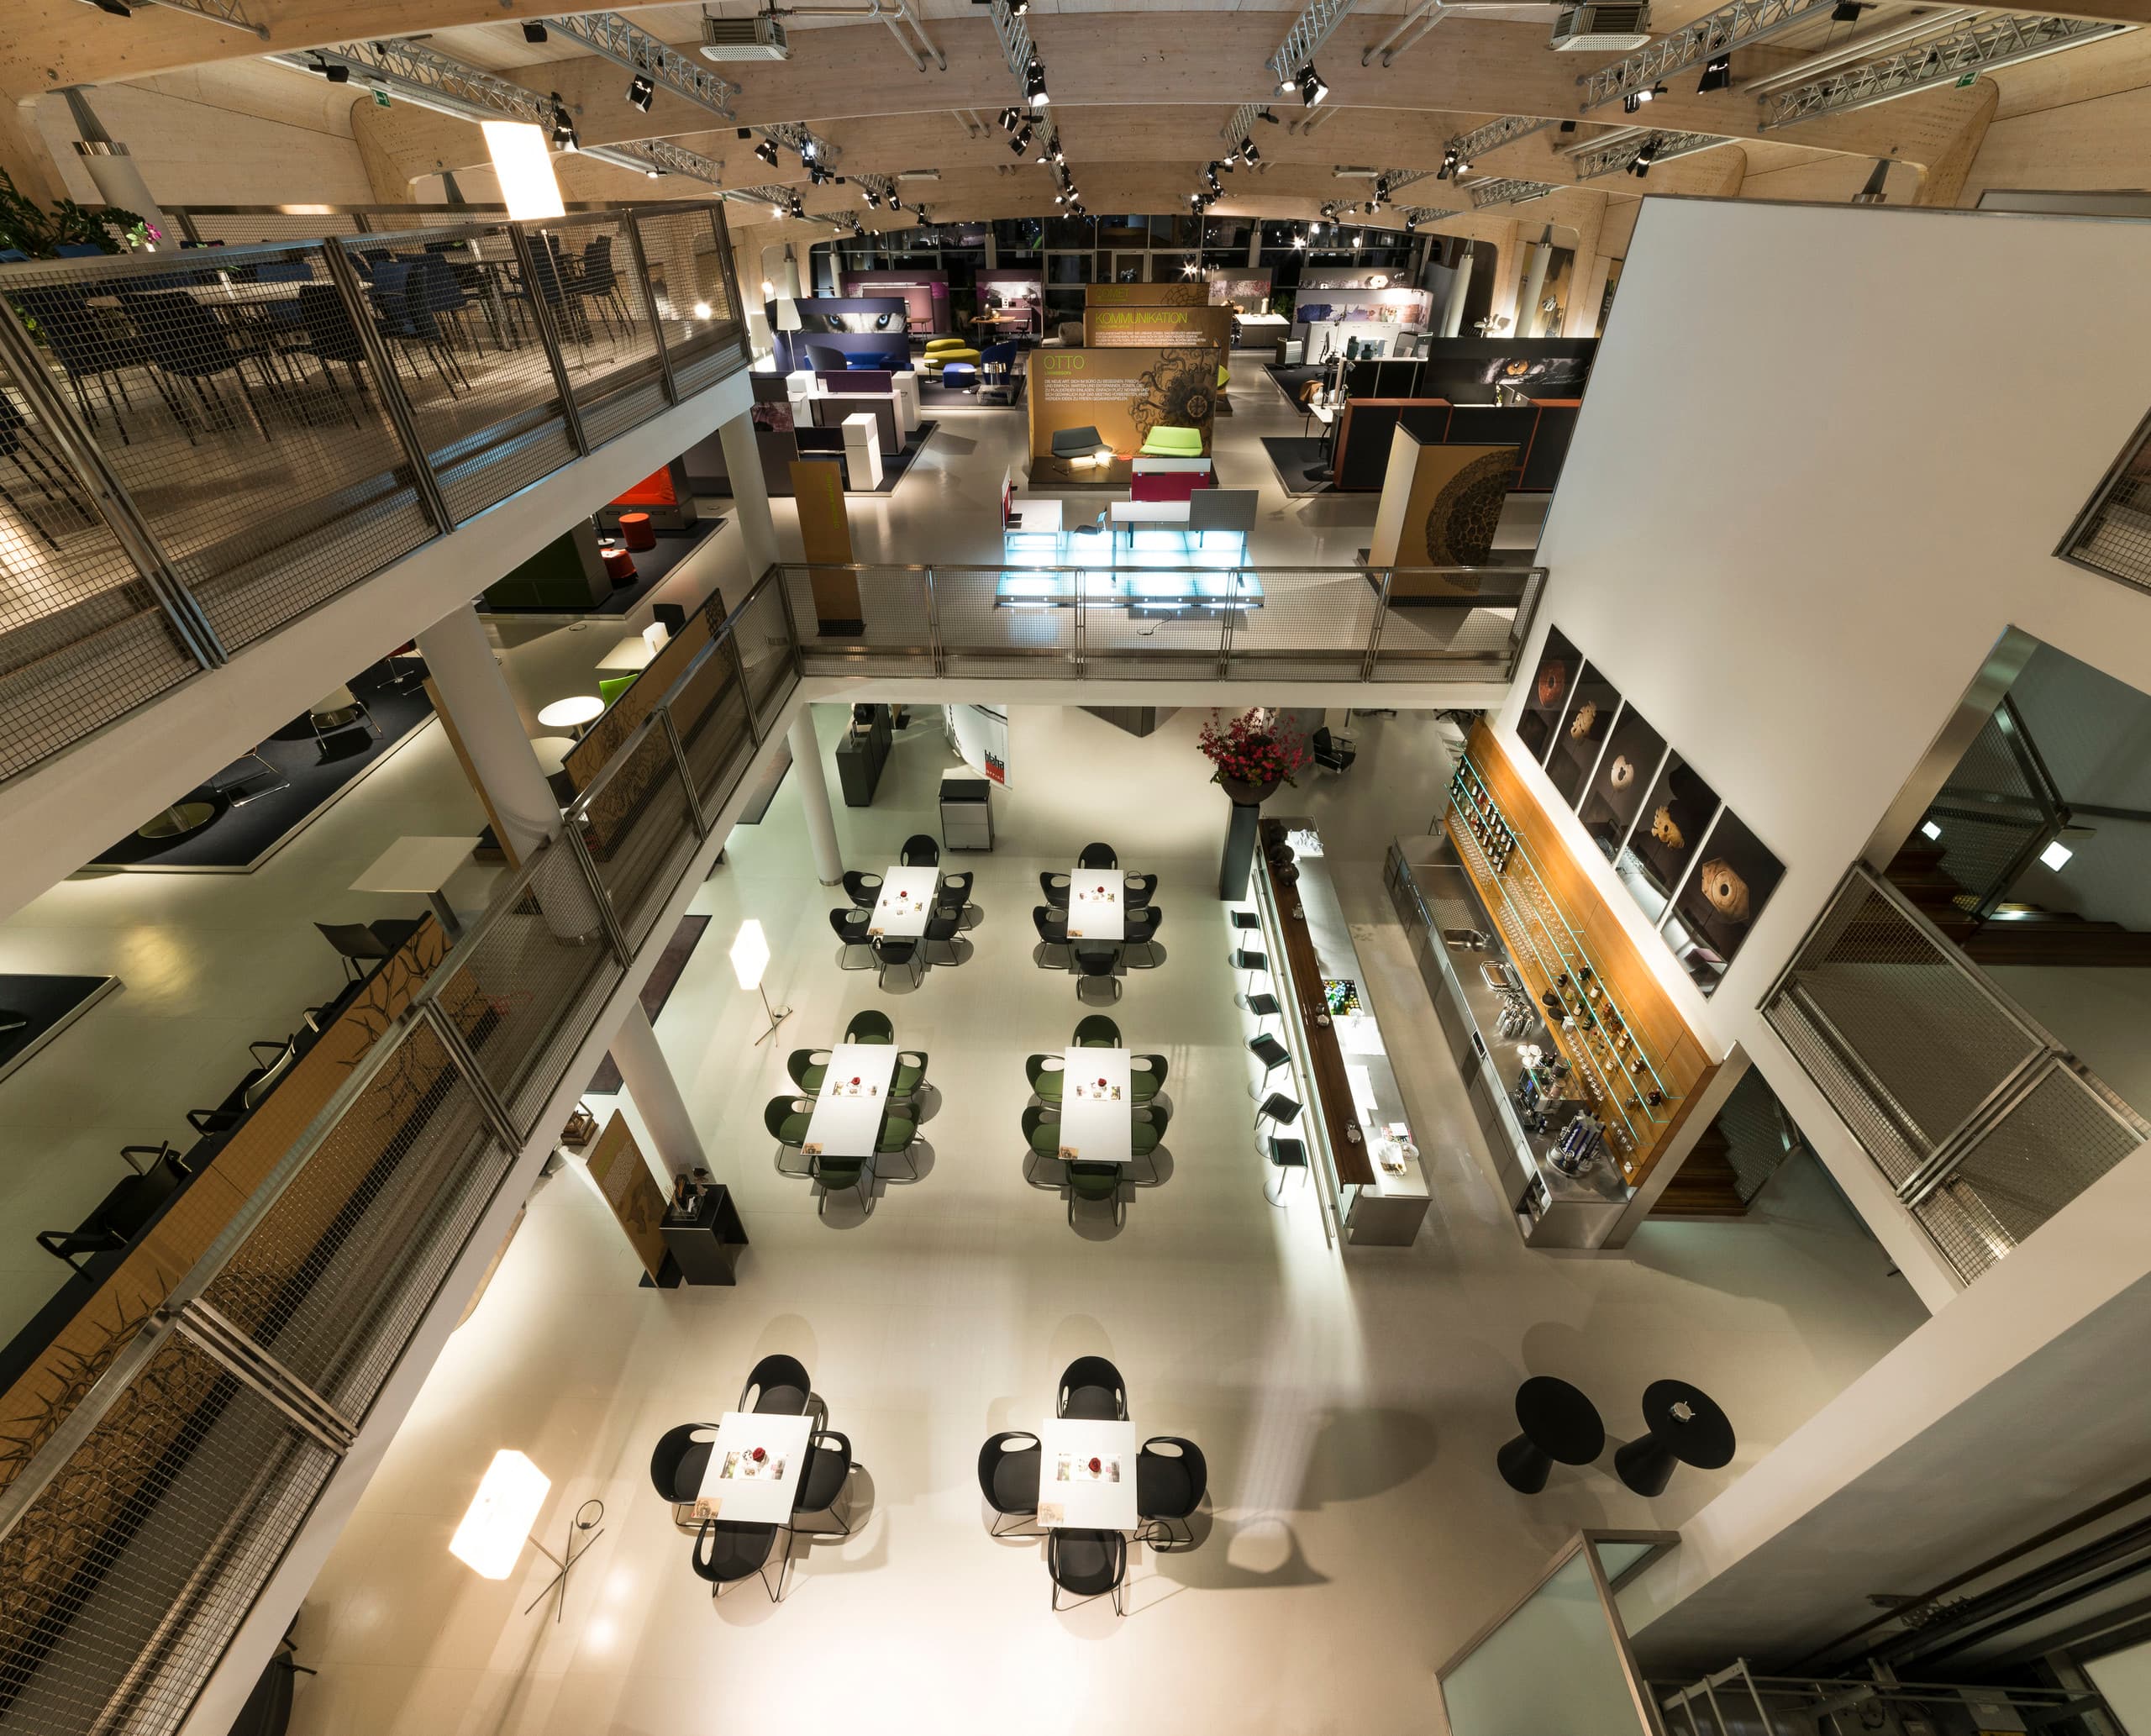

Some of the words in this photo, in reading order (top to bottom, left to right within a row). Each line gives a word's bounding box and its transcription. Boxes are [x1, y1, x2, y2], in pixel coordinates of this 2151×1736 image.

[1096, 312, 1188, 324] KOMMUNIKATION
[1044, 355, 1085, 370] OTTO
[985, 749, 1004, 770] blaha
